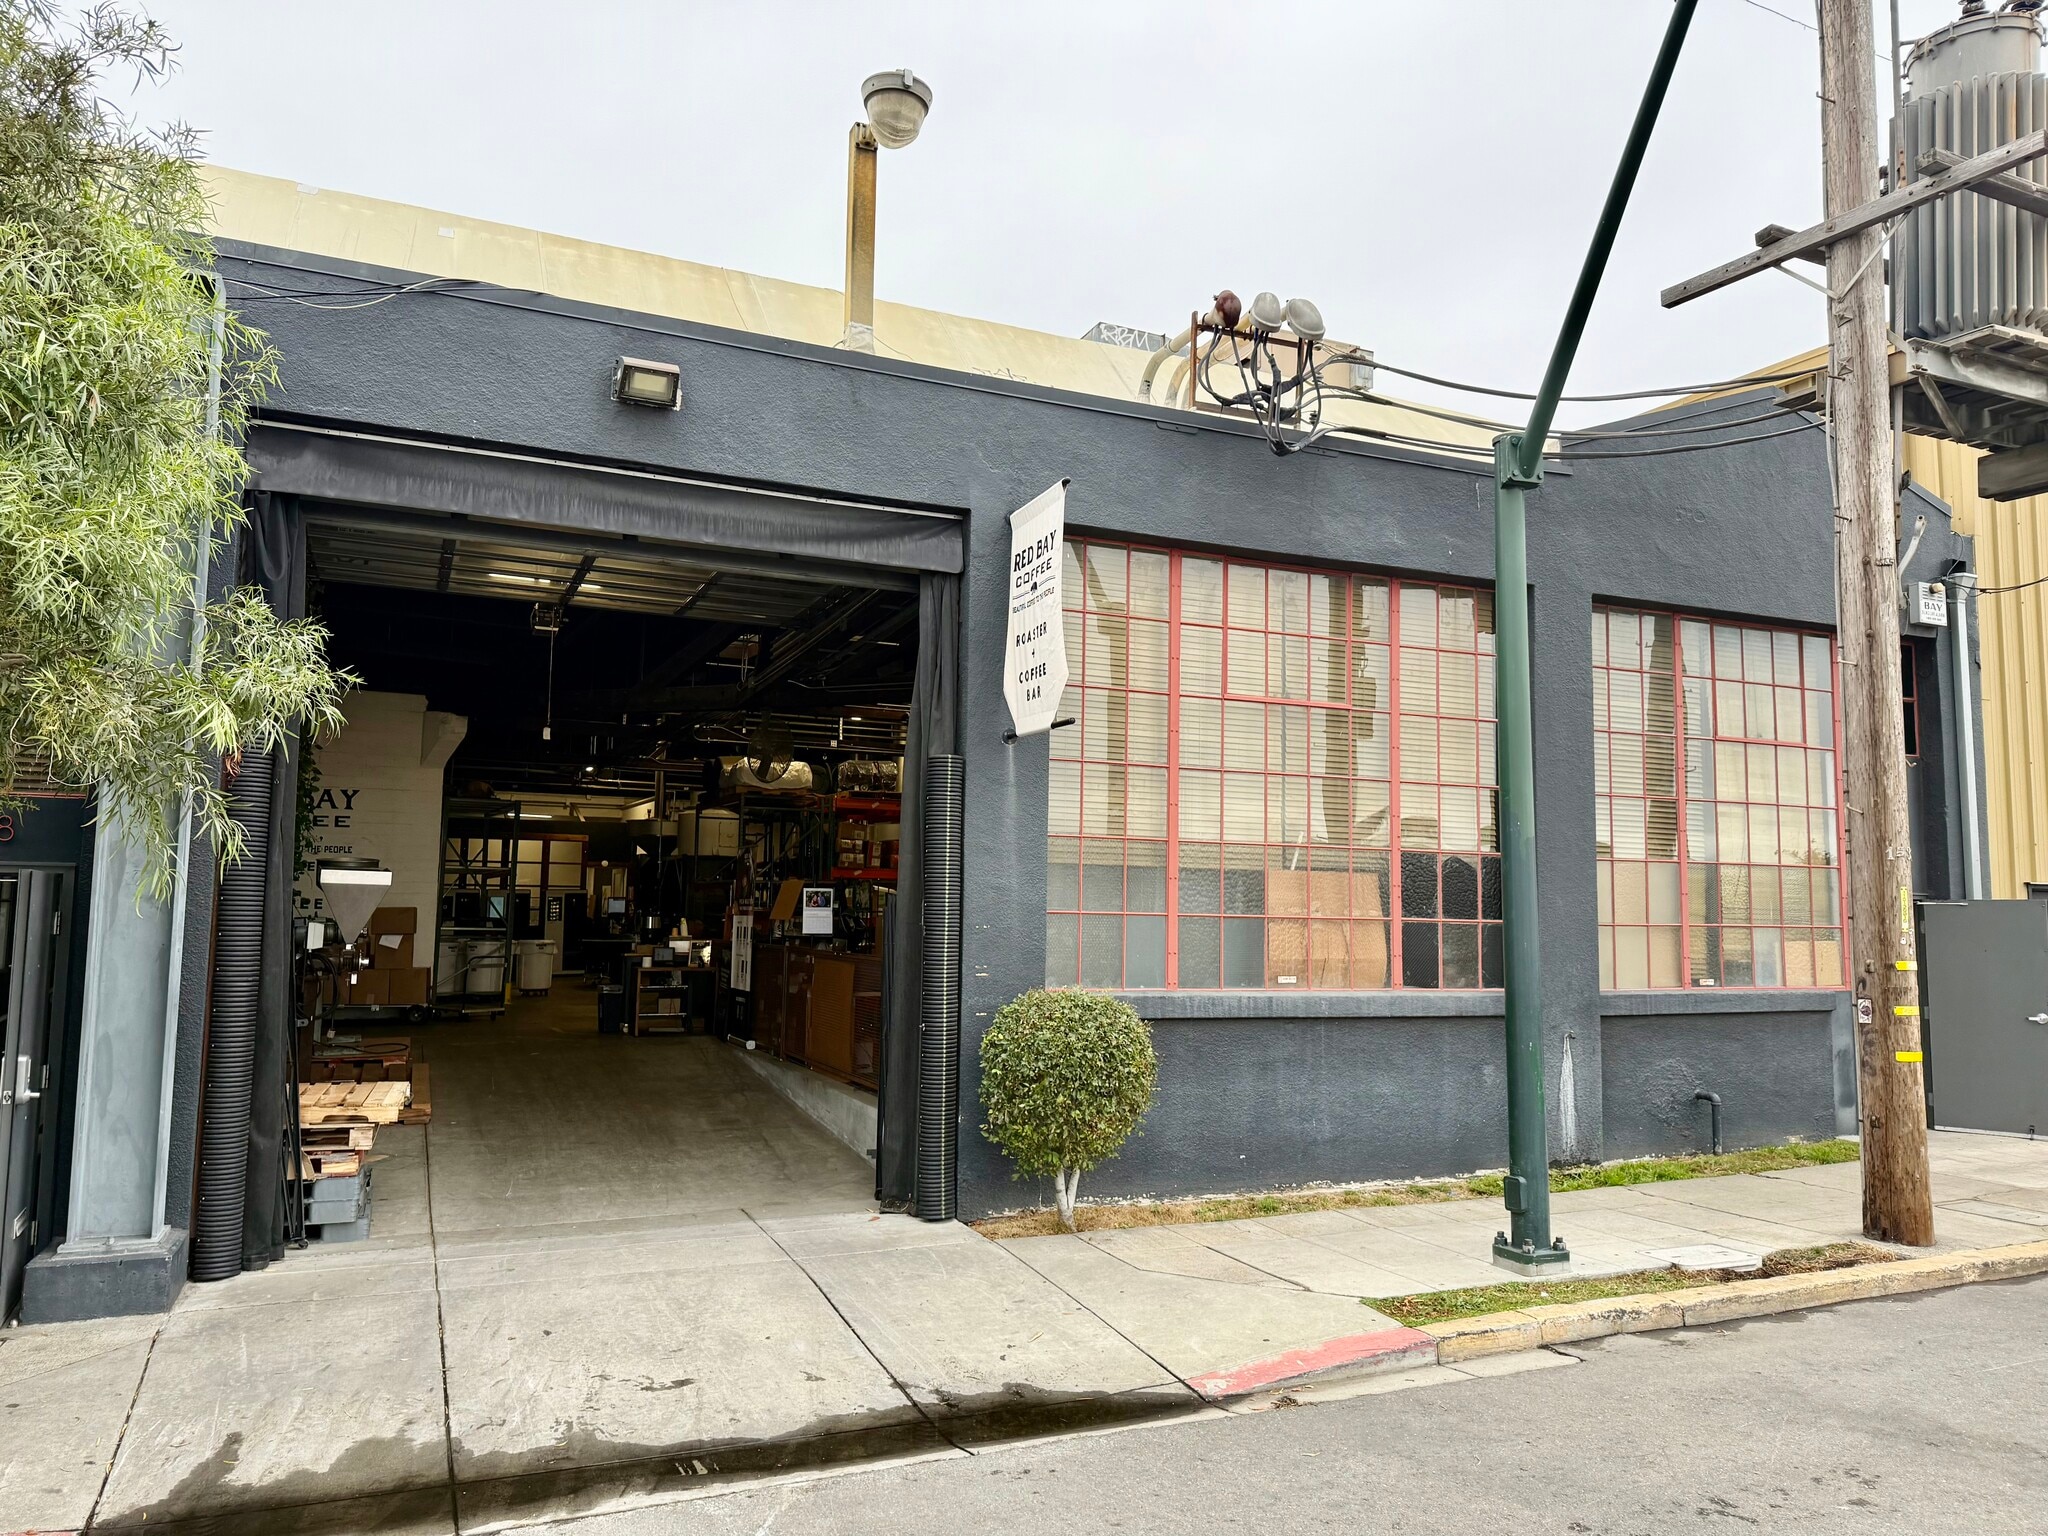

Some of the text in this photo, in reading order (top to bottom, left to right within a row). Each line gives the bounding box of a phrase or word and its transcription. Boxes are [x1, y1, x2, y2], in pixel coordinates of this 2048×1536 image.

[1013, 529, 1057, 572] RED BAY
[1015, 557, 1052, 588] COFFEE
[1924, 601, 1943, 611] BAY
[1016, 621, 1047, 647] ROASTER
[1019, 662, 1047, 684] COFFEE
[1026, 685, 1041, 702] BAR
[324, 845, 353, 854] PEOPLE
